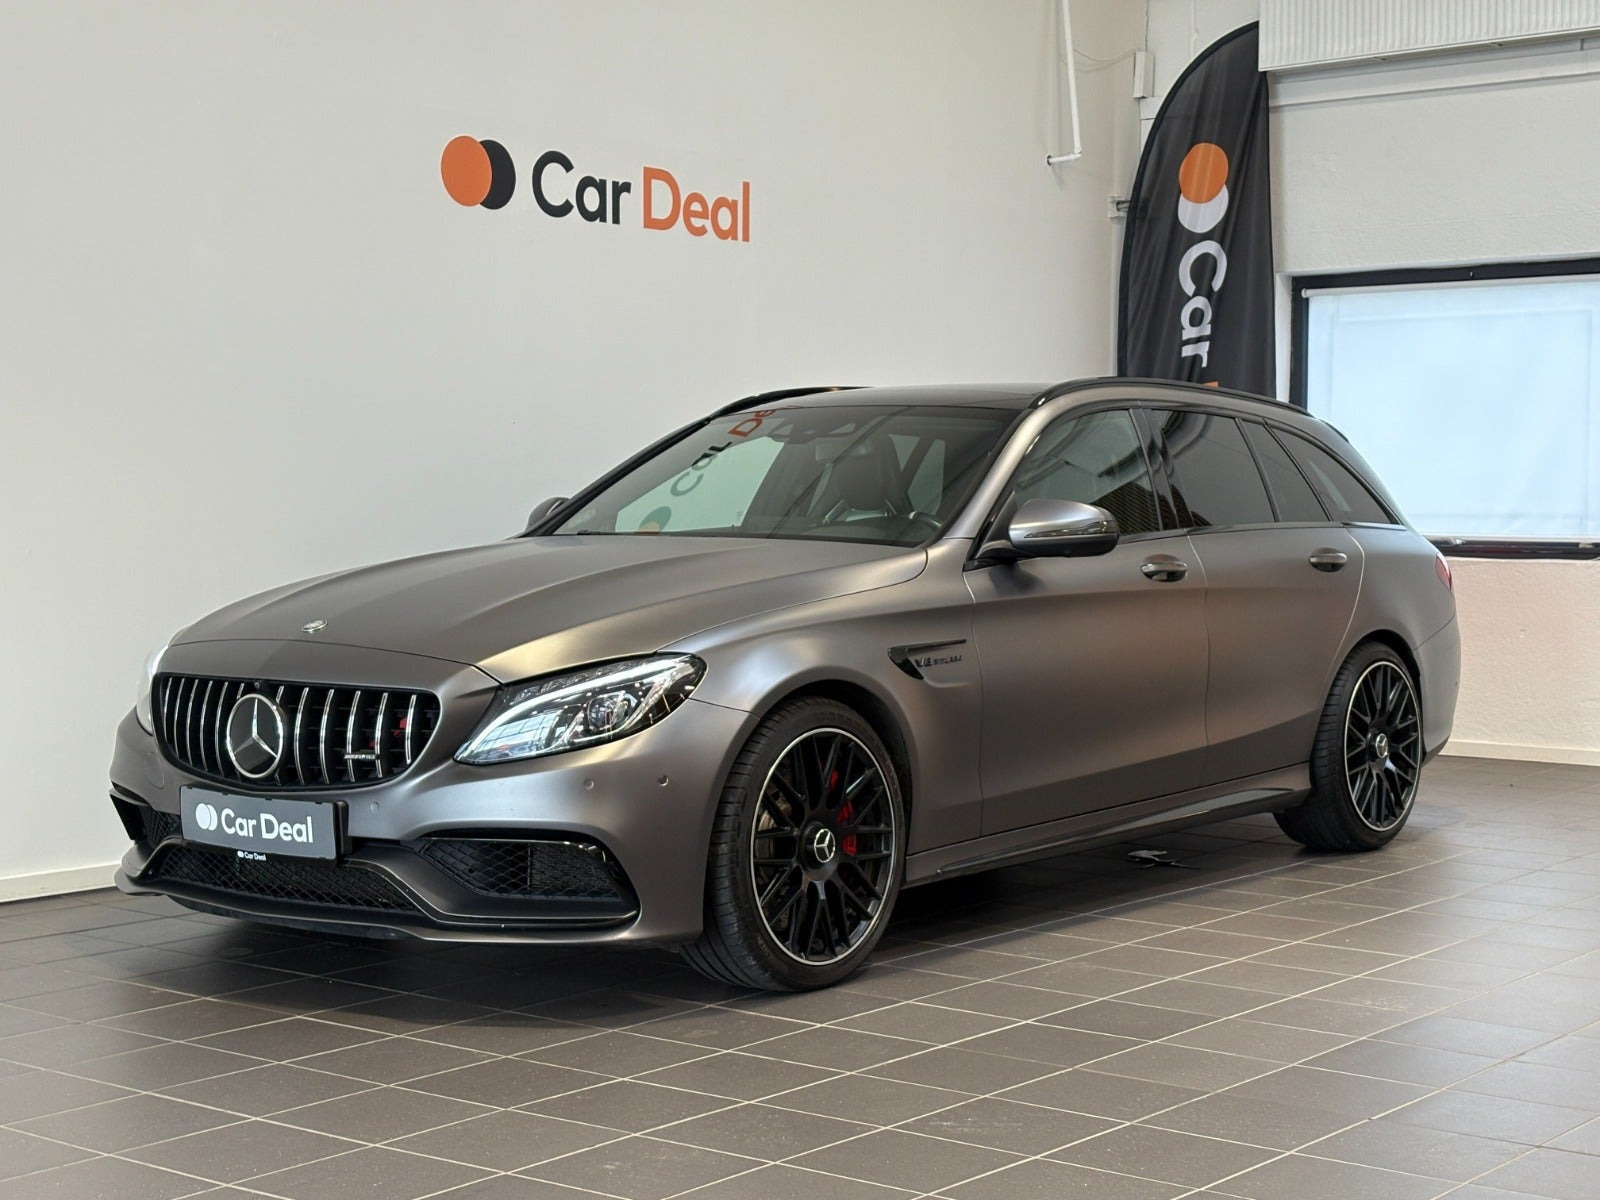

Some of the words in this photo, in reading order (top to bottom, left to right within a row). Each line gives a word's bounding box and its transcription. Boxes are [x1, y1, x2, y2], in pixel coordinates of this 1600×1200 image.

[532, 150, 632, 225] Car
[643, 166, 750, 242] Deal
[1178, 240, 1227, 368] Car
[221, 807, 256, 838] Car
[259, 813, 313, 843] Deal
